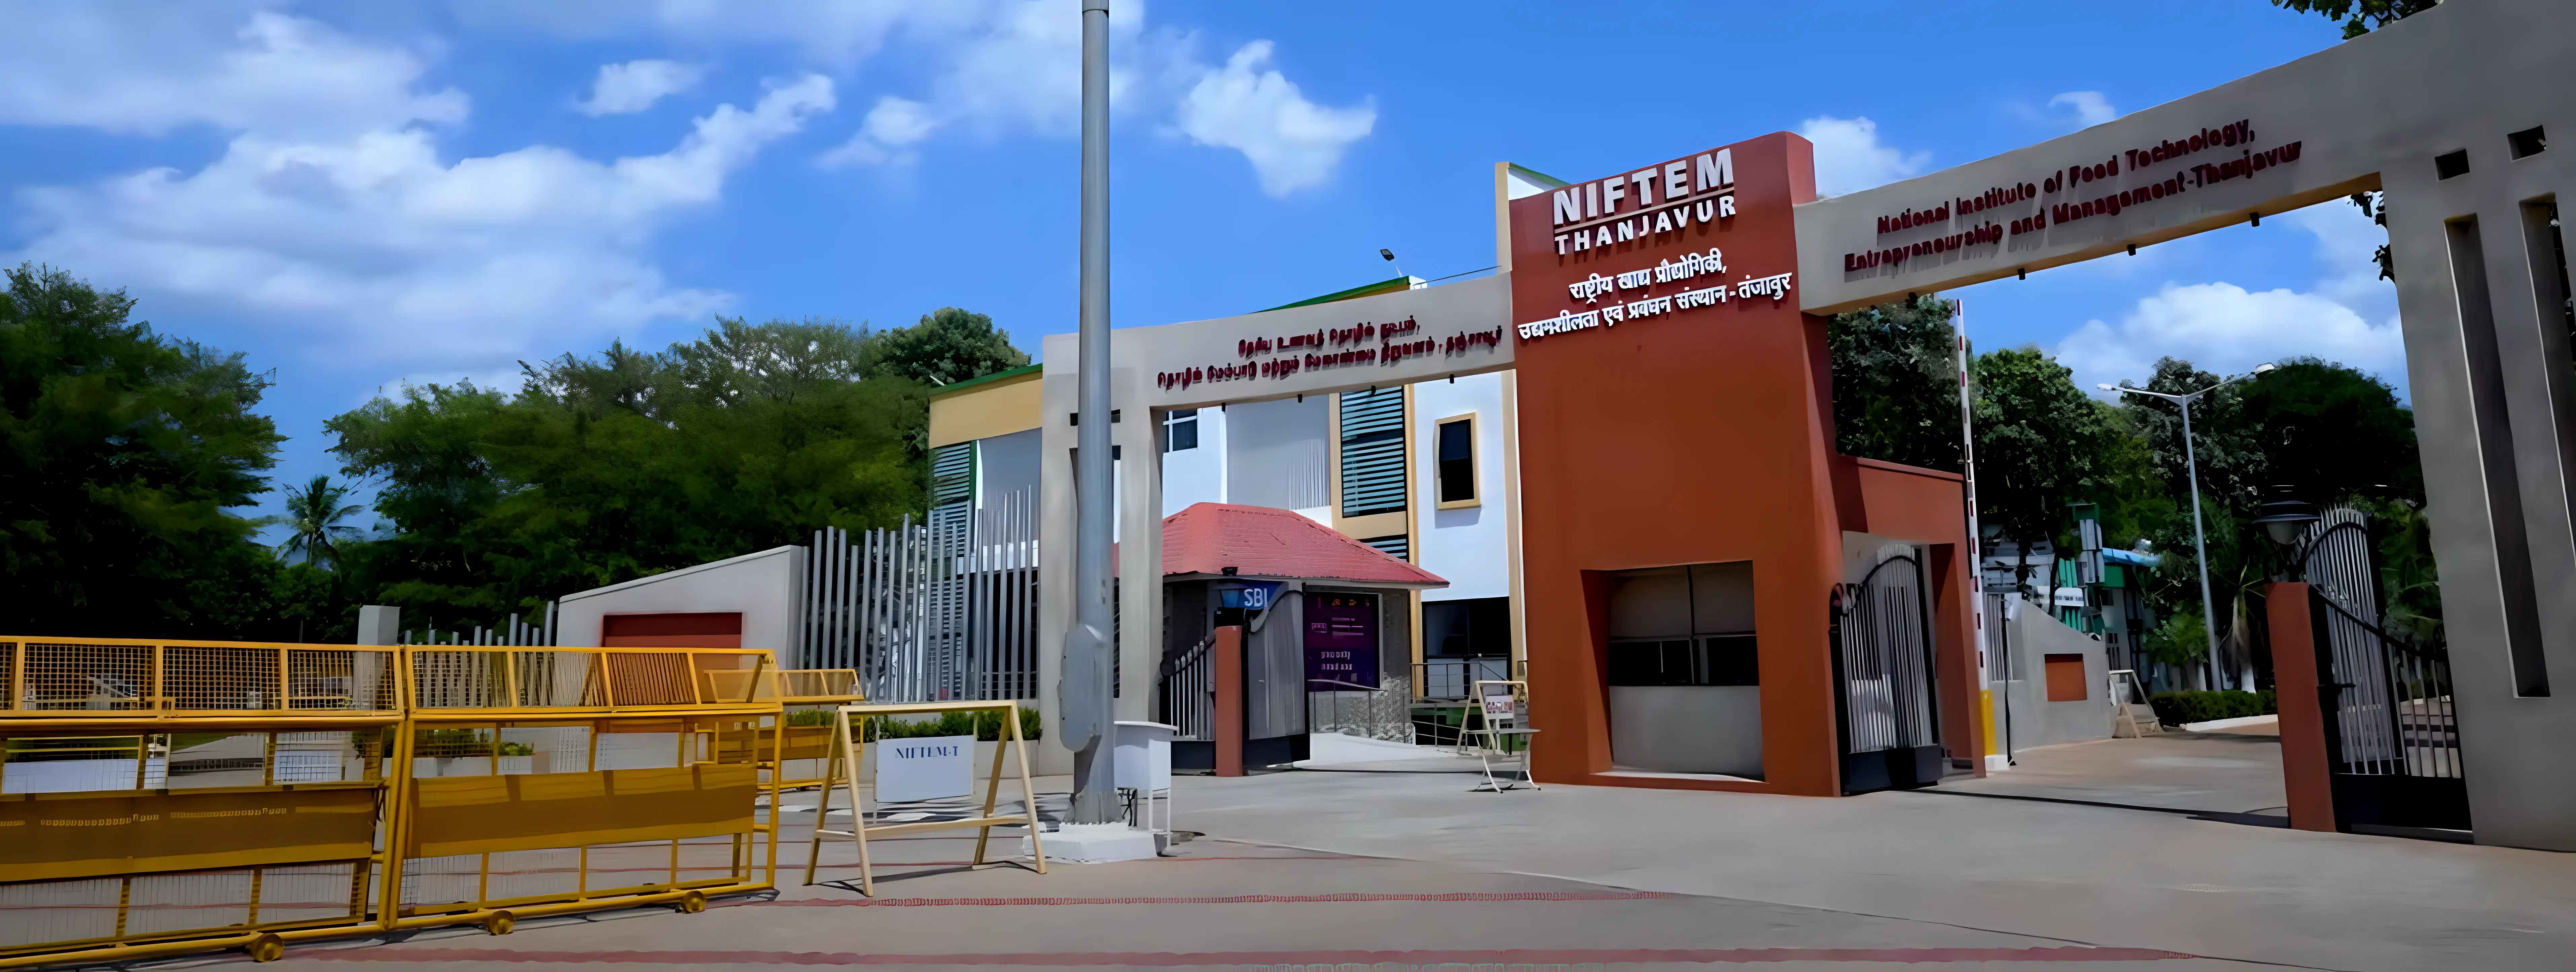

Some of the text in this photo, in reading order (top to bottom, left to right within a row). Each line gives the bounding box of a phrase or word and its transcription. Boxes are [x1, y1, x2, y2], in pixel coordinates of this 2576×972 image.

[1553, 148, 1734, 224] NIFTEM
[1877, 201, 1949, 234] National
[1956, 183, 2036, 215] Institute
[2069, 155, 2119, 188] Food
[1554, 196, 1736, 255] THANJAVUR
[1845, 221, 2003, 272] Entrepreneurship
[2010, 206, 2046, 235] and
[1569, 273, 1614, 304] राष्ट्रीय
[1602, 300, 1624, 326] एवं
[1674, 287, 1727, 309] संस्थान
[1244, 588, 1267, 607] SBI
